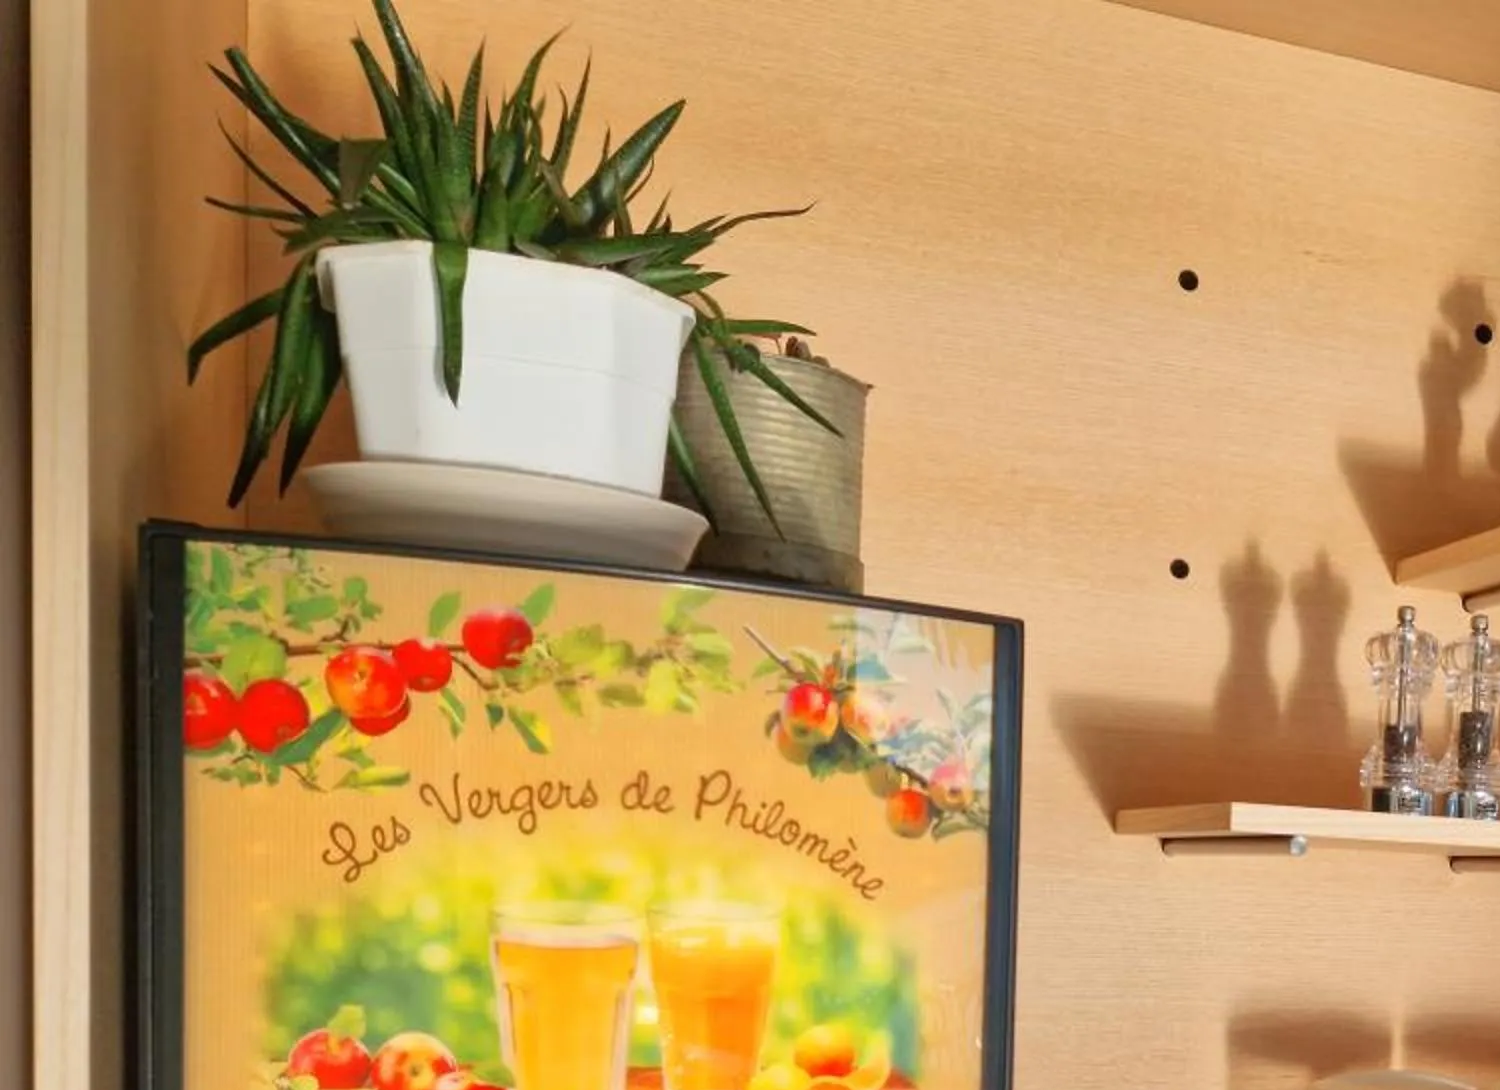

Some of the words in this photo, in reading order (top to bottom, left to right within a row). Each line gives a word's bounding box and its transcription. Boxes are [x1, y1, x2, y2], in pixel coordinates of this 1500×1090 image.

[322, 816, 410, 882] Les
[419, 772, 598, 834] Vergers
[620, 770, 675, 814] de
[693, 769, 885, 901] Philomène
